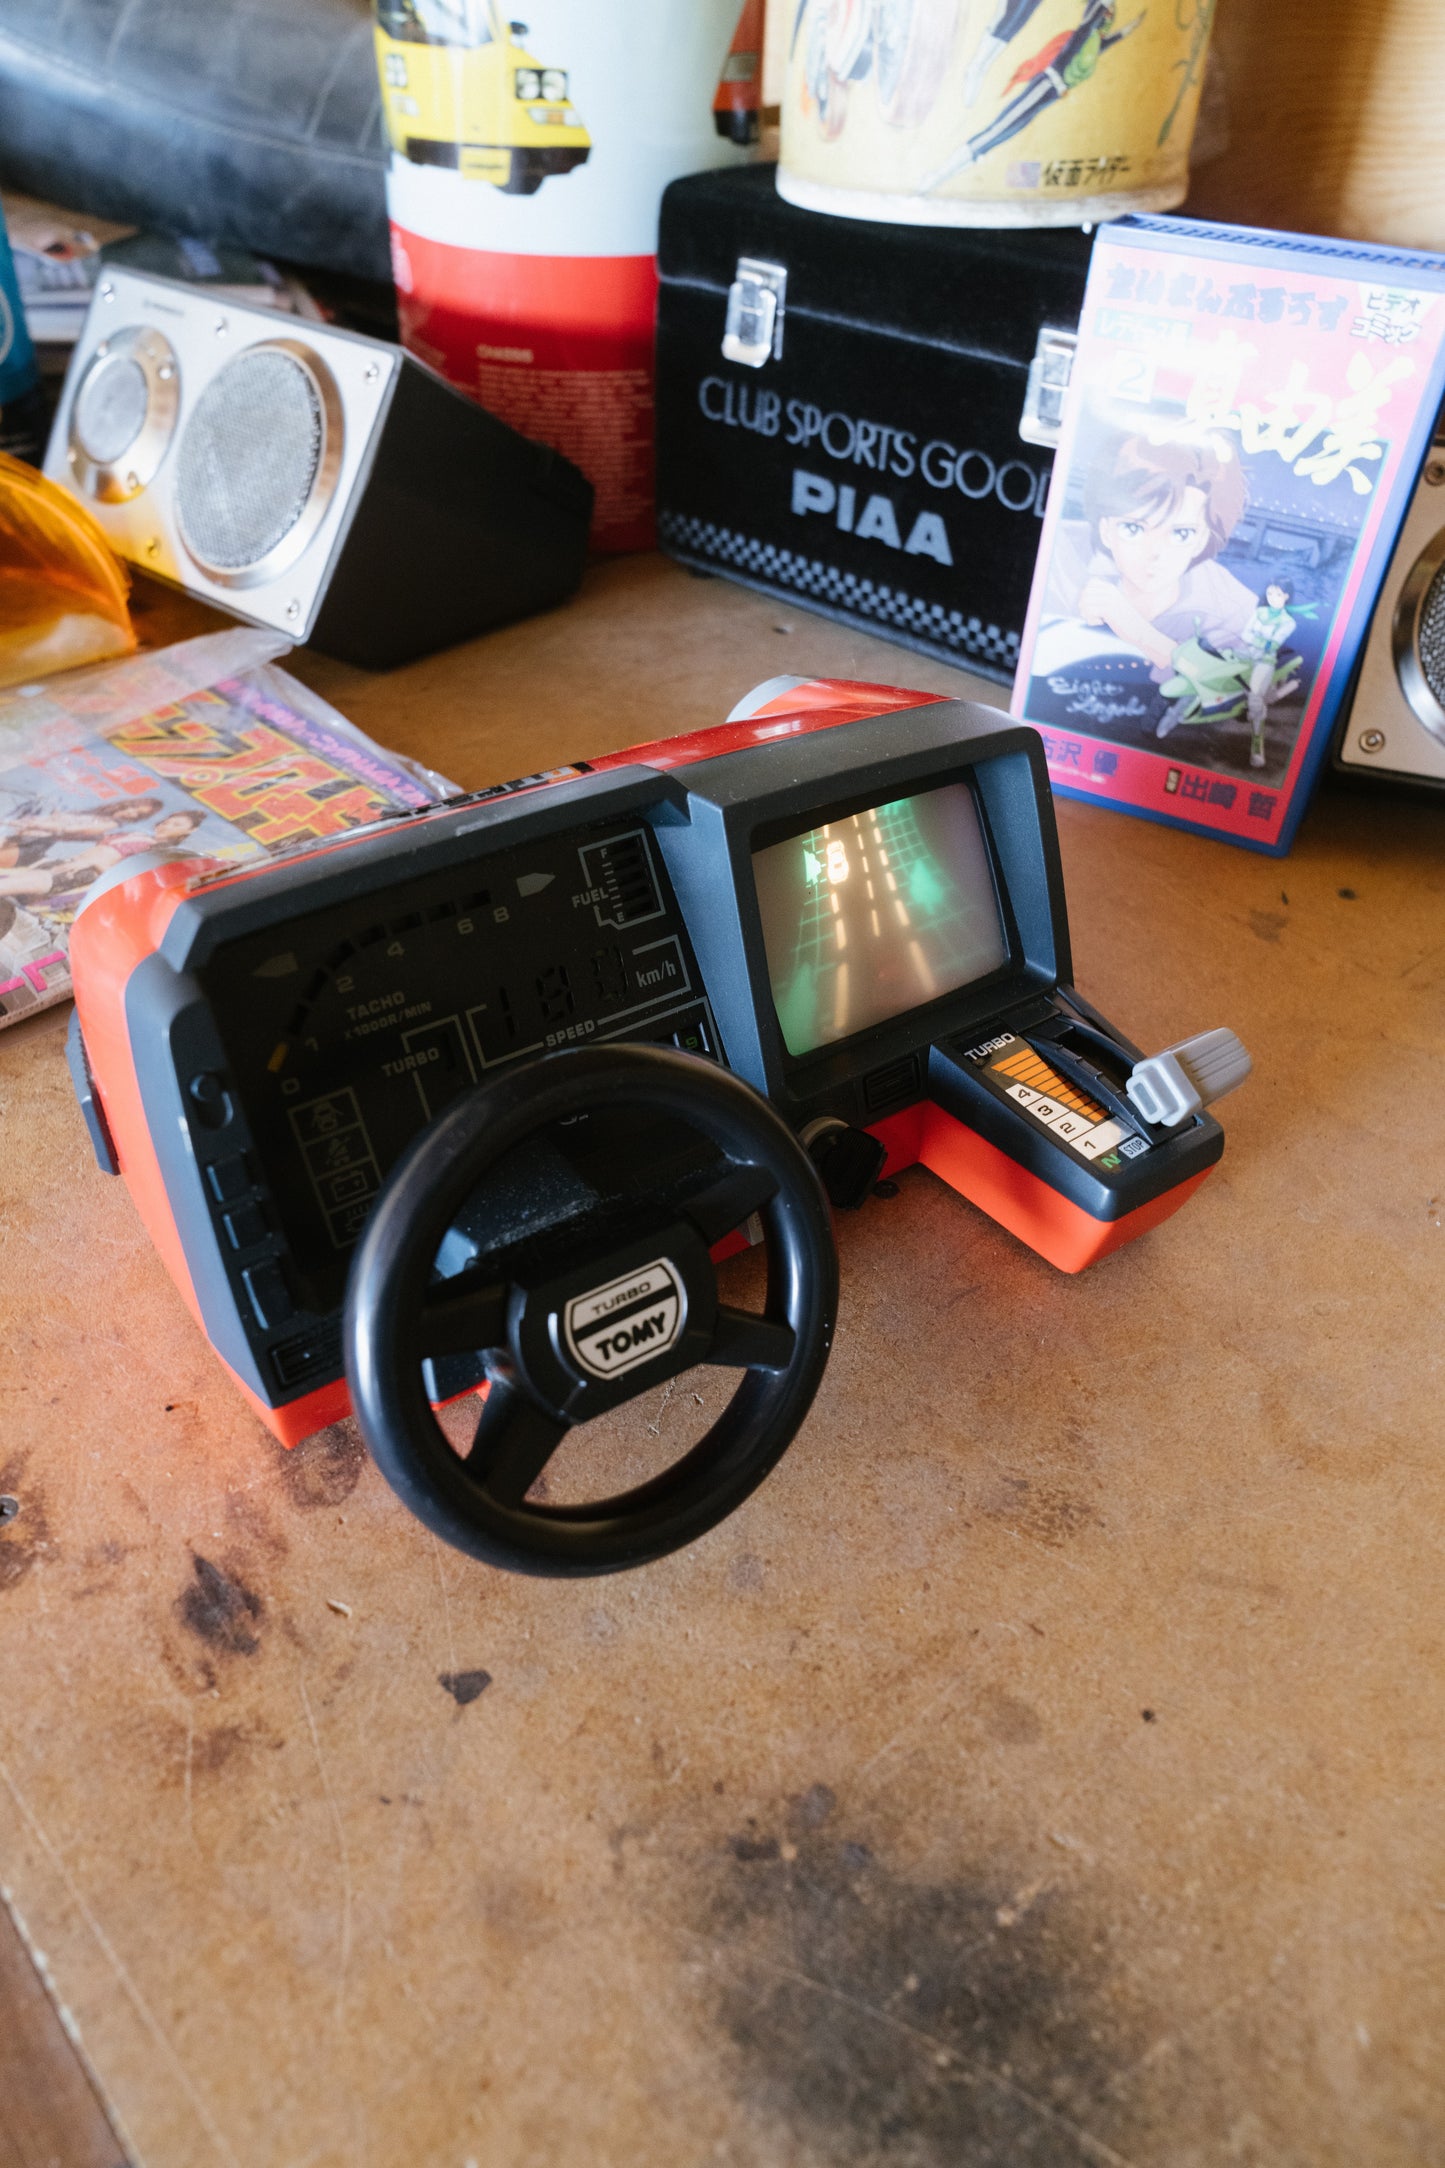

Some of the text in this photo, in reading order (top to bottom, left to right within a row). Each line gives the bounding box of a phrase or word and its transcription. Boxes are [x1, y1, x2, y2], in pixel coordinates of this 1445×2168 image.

[1042, 156, 1131, 187] 仮面ライダー
[1366, 291, 1421, 315] ビデオ
[1350, 315, 1423, 345] コミック
[1116, 356, 1147, 393] 2
[699, 375, 782, 437] CLUB
[785, 398, 917, 478] SPORTS
[791, 468, 954, 567] PIAA
[571, 887, 609, 908] FUEL
[336, 976, 355, 993] 2
[387, 941, 405, 957] 4
[457, 917, 475, 935] 6
[493, 905, 510, 924] 8
[636, 959, 677, 987] km/h
[347, 991, 406, 1020] TACHO
[545, 1019, 596, 1048] SPEED
[964, 1032, 1016, 1060] TURBO
[381, 1047, 440, 1077] TURBO
[1017, 1088, 1031, 1099] 4
[1037, 1103, 1054, 1117] 3
[1059, 1121, 1076, 1134] 2
[1083, 1139, 1097, 1150] 1
[1101, 1139, 1144, 1168] N STOP
[591, 1281, 651, 1315] TURBO
[595, 1311, 666, 1361] TOMY
